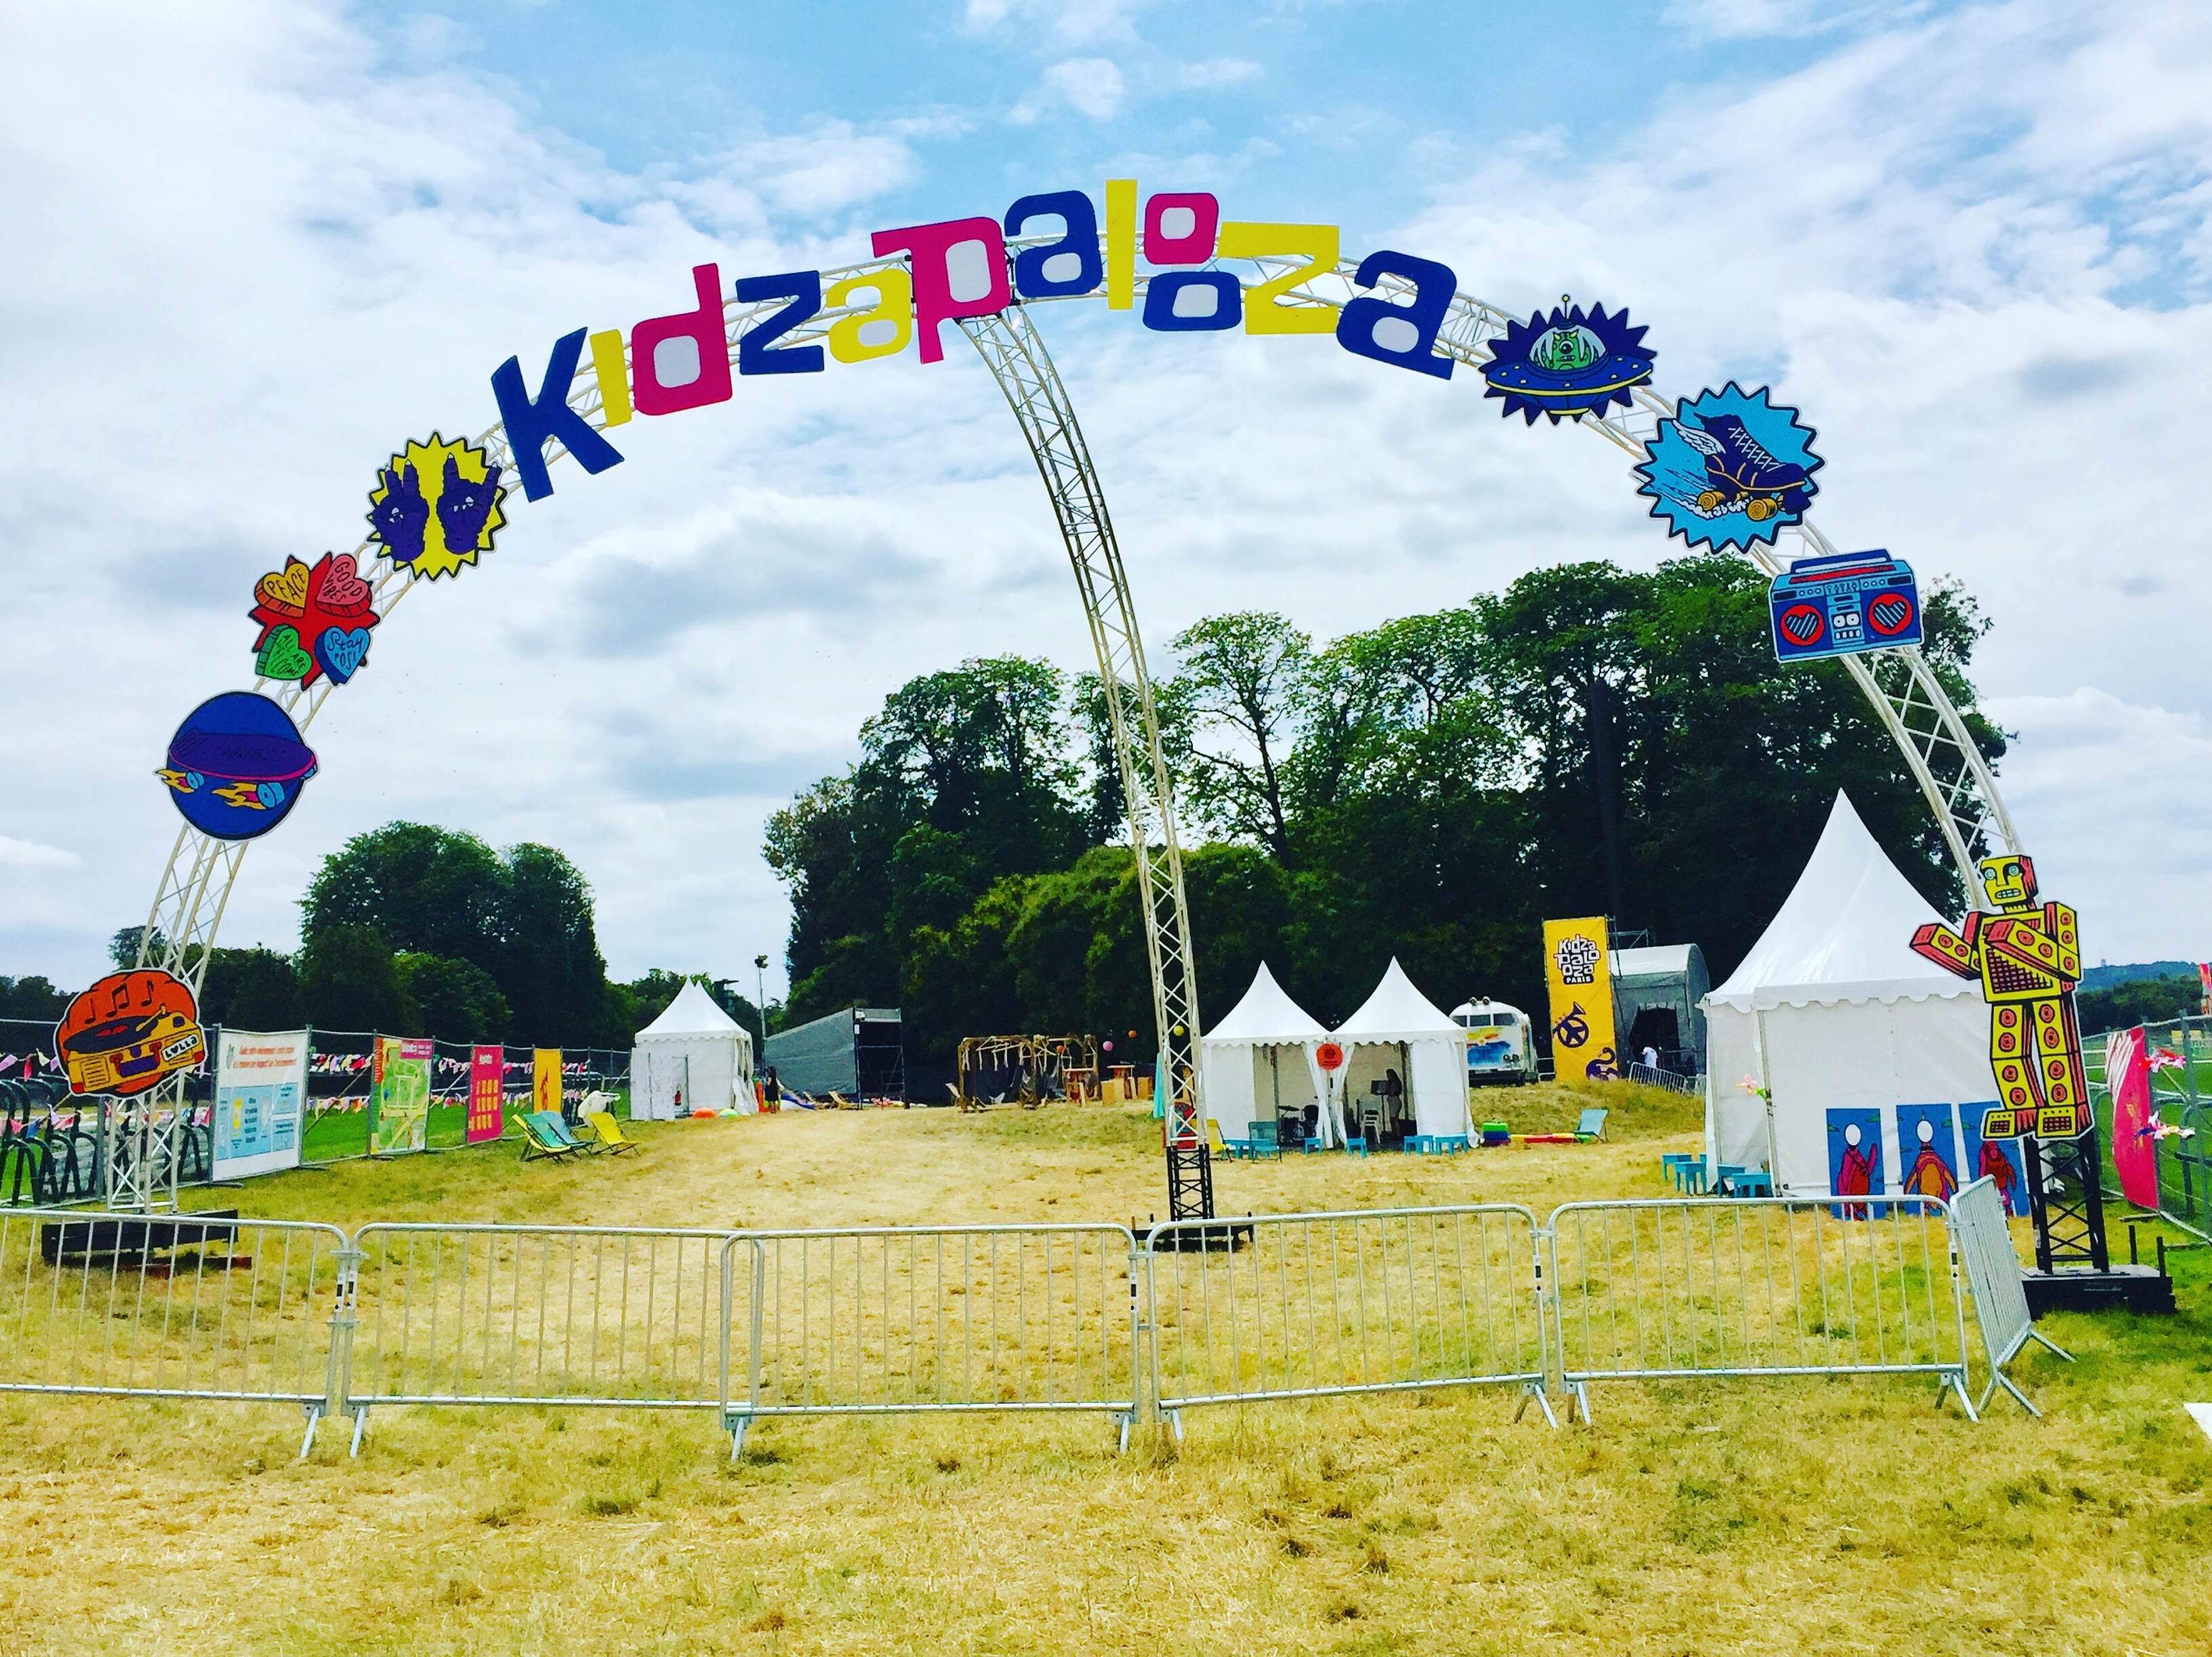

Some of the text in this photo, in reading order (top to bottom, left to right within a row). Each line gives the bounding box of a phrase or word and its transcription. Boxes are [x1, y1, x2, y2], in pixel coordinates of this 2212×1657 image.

[266, 568, 306, 600] PEACE
[323, 573, 347, 602] VIBES
[335, 561, 363, 596] GOOD
[283, 634, 306, 671] ALL ARE
[327, 631, 364, 653] Stay
